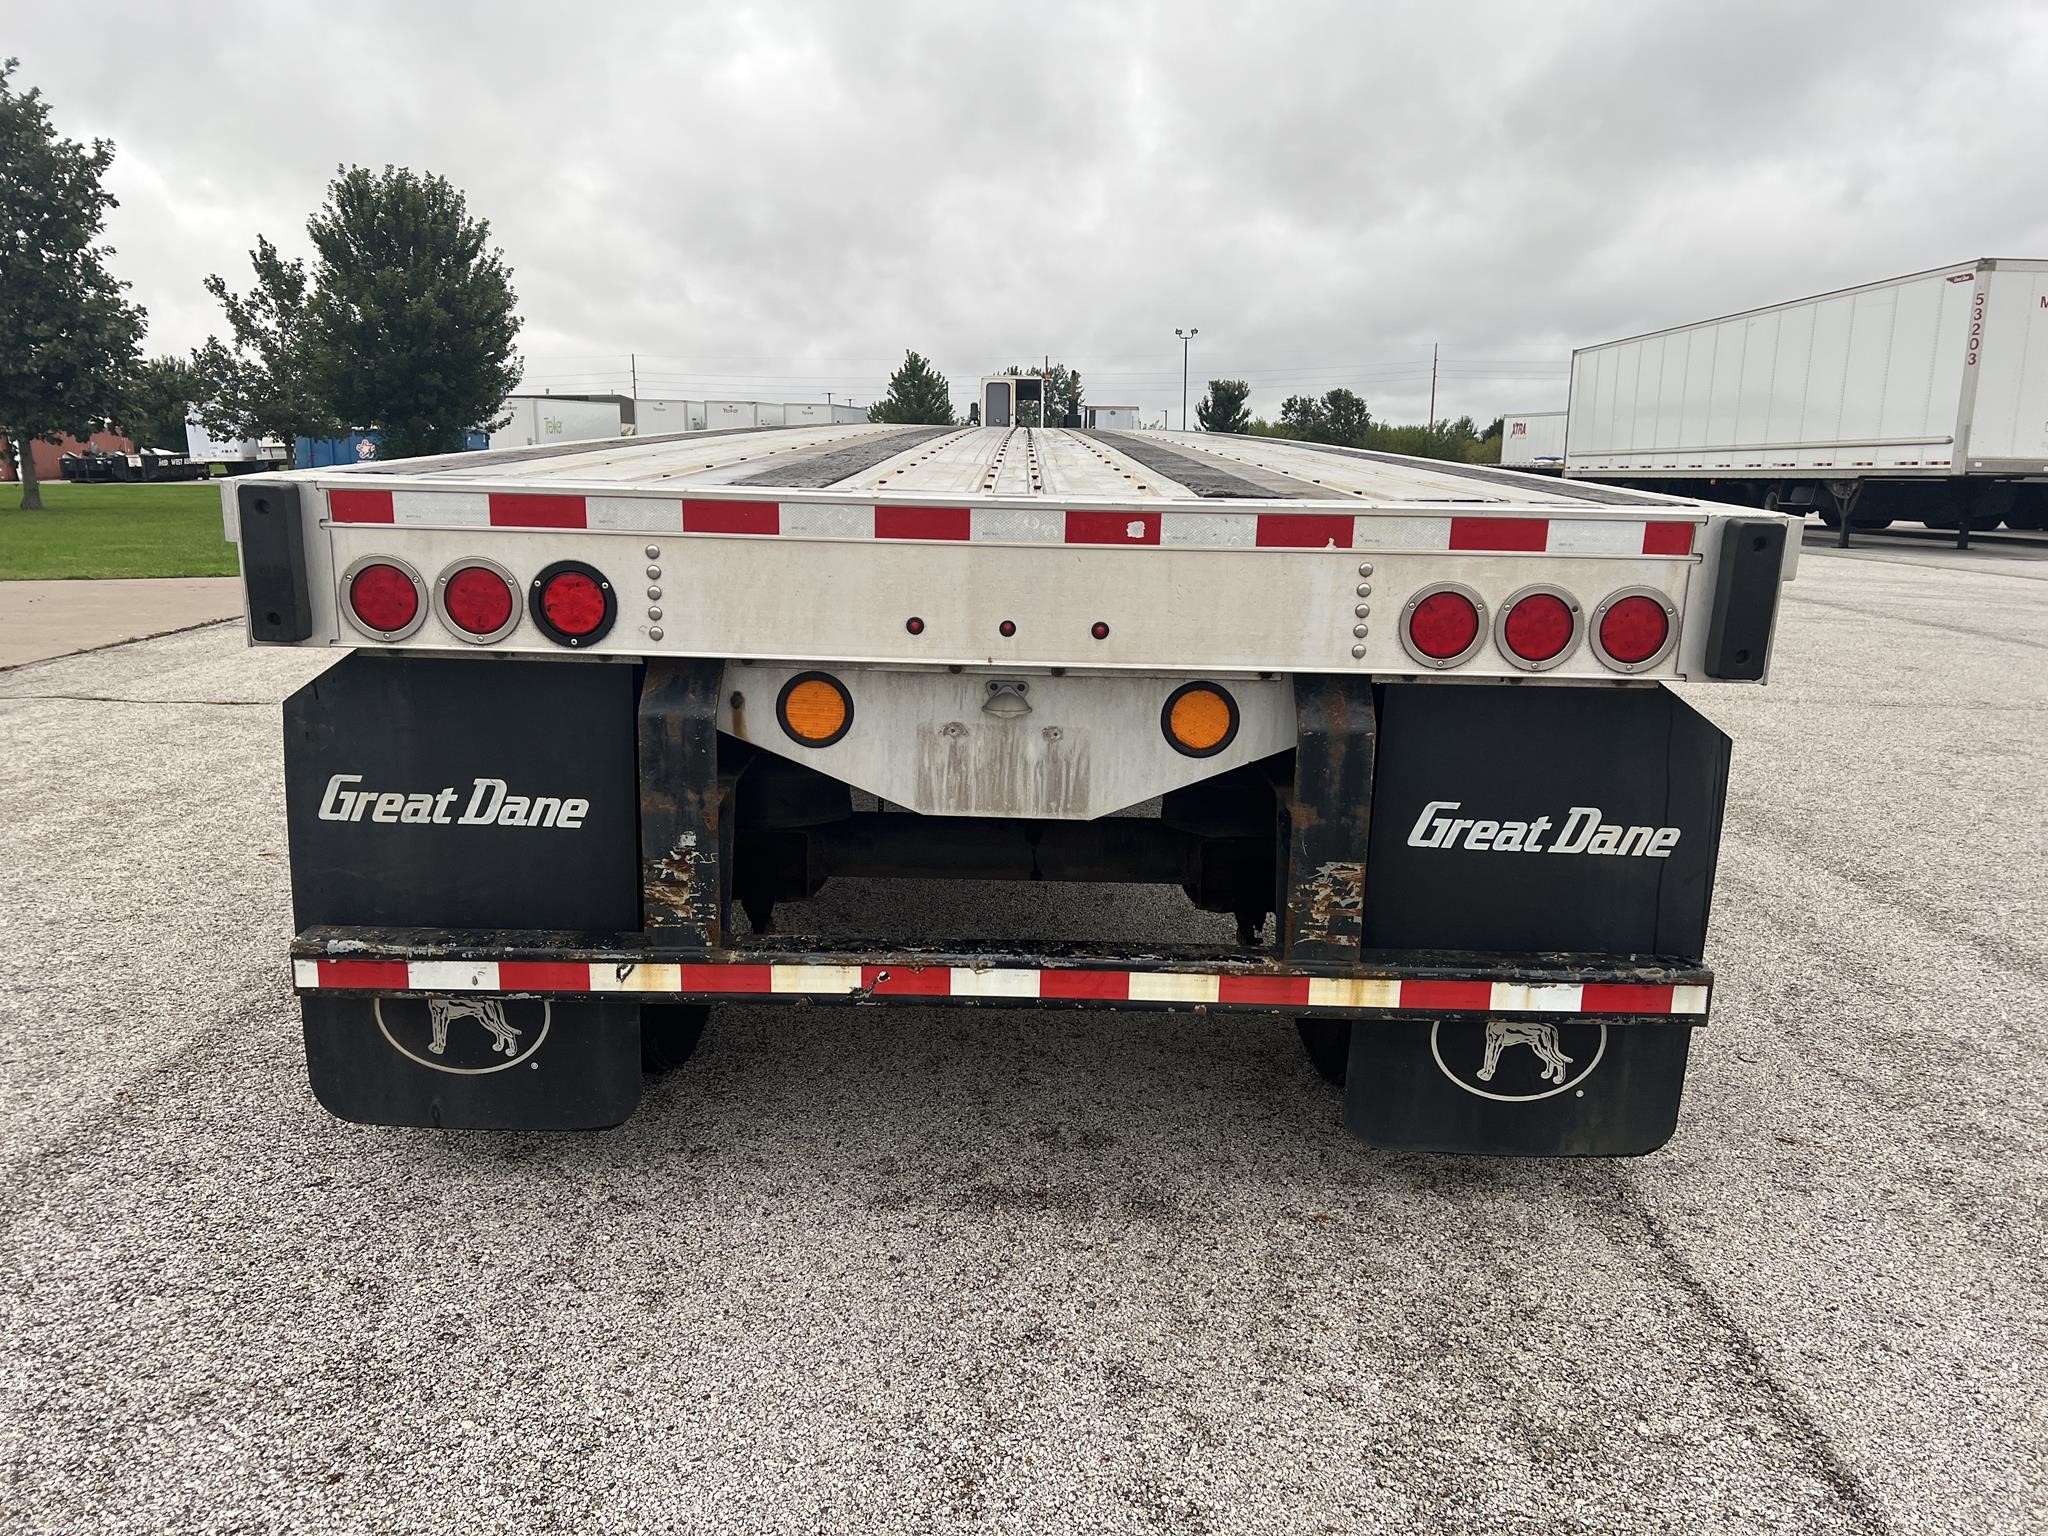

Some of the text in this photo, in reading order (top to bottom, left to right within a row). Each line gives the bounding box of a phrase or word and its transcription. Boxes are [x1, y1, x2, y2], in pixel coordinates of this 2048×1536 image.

[1967, 292, 1985, 366] 53203
[1510, 422, 1527, 439] XTRA
[318, 773, 590, 829] Great Dane
[1407, 800, 1682, 857] Great Dane
